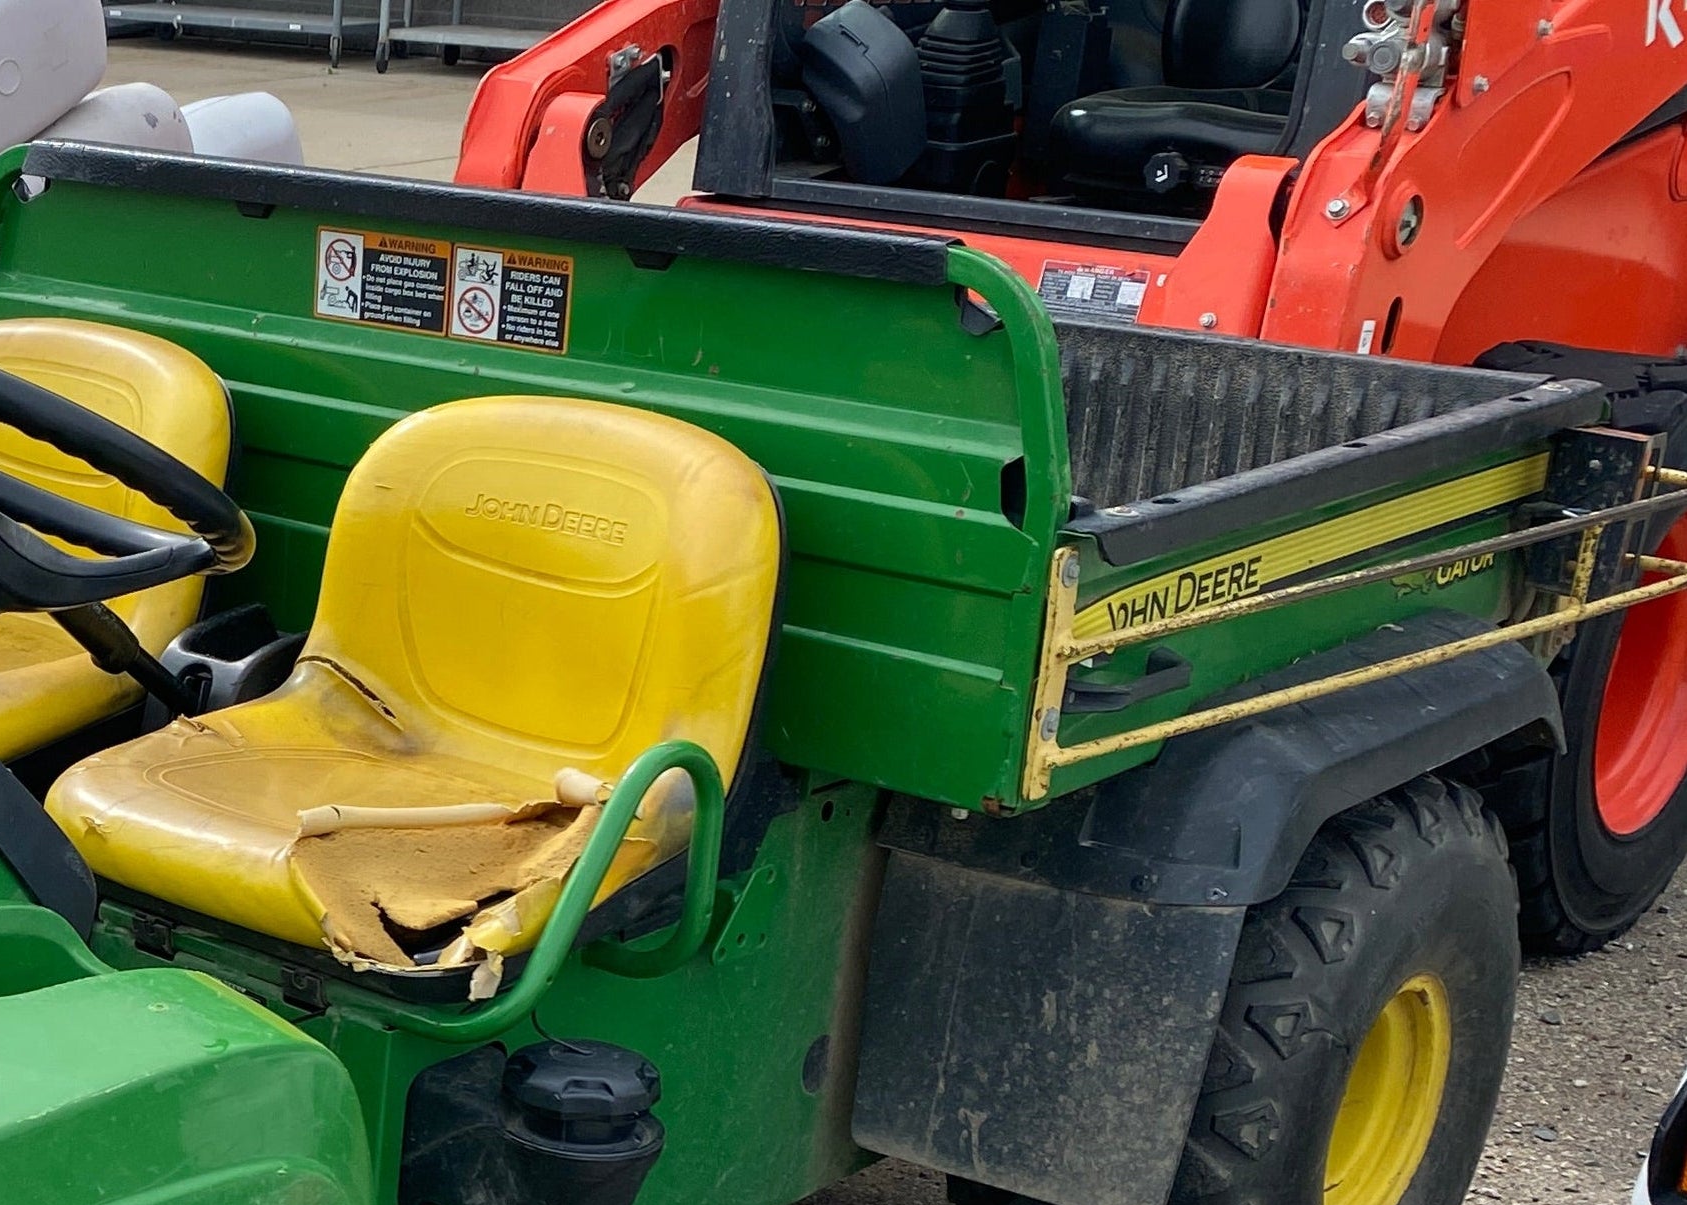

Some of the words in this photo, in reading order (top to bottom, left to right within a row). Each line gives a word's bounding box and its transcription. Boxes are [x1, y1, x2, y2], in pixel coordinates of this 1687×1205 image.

[1644, 0, 1687, 49] K
[387, 238, 435, 254] WARNING
[379, 254, 402, 264] AVOID
[403, 257, 431, 268] INJURY
[518, 255, 569, 271] WARNING
[371, 264, 392, 274] FROM
[394, 266, 438, 280] EXPLOSION
[511, 271, 541, 283] RIDERS
[543, 276, 560, 285] CAN
[366, 283, 384, 292] inside
[385, 287, 401, 296] cargo
[387, 278, 402, 286] place
[416, 282, 445, 291] container
[505, 282, 525, 292] FALL
[527, 285, 544, 294] OFF
[545, 288, 563, 297] AND
[365, 292, 382, 303] filling
[511, 294, 522, 303] BE
[524, 296, 553, 307] KILLED
[365, 301, 381, 310] Place
[394, 307, 422, 316] container
[507, 305, 538, 315] Maximum
[386, 313, 402, 322] when
[403, 316, 420, 326] filling
[506, 315, 529, 323] person
[506, 323, 516, 331] No
[516, 326, 535, 334] riders
[536, 327, 543, 335] in
[544, 329, 557, 337] box
[513, 335, 544, 343] anywhere
[545, 339, 559, 347] else
[464, 493, 540, 525] JOHN
[541, 503, 629, 547] DEERE
[1174, 555, 1262, 613] DEERE
